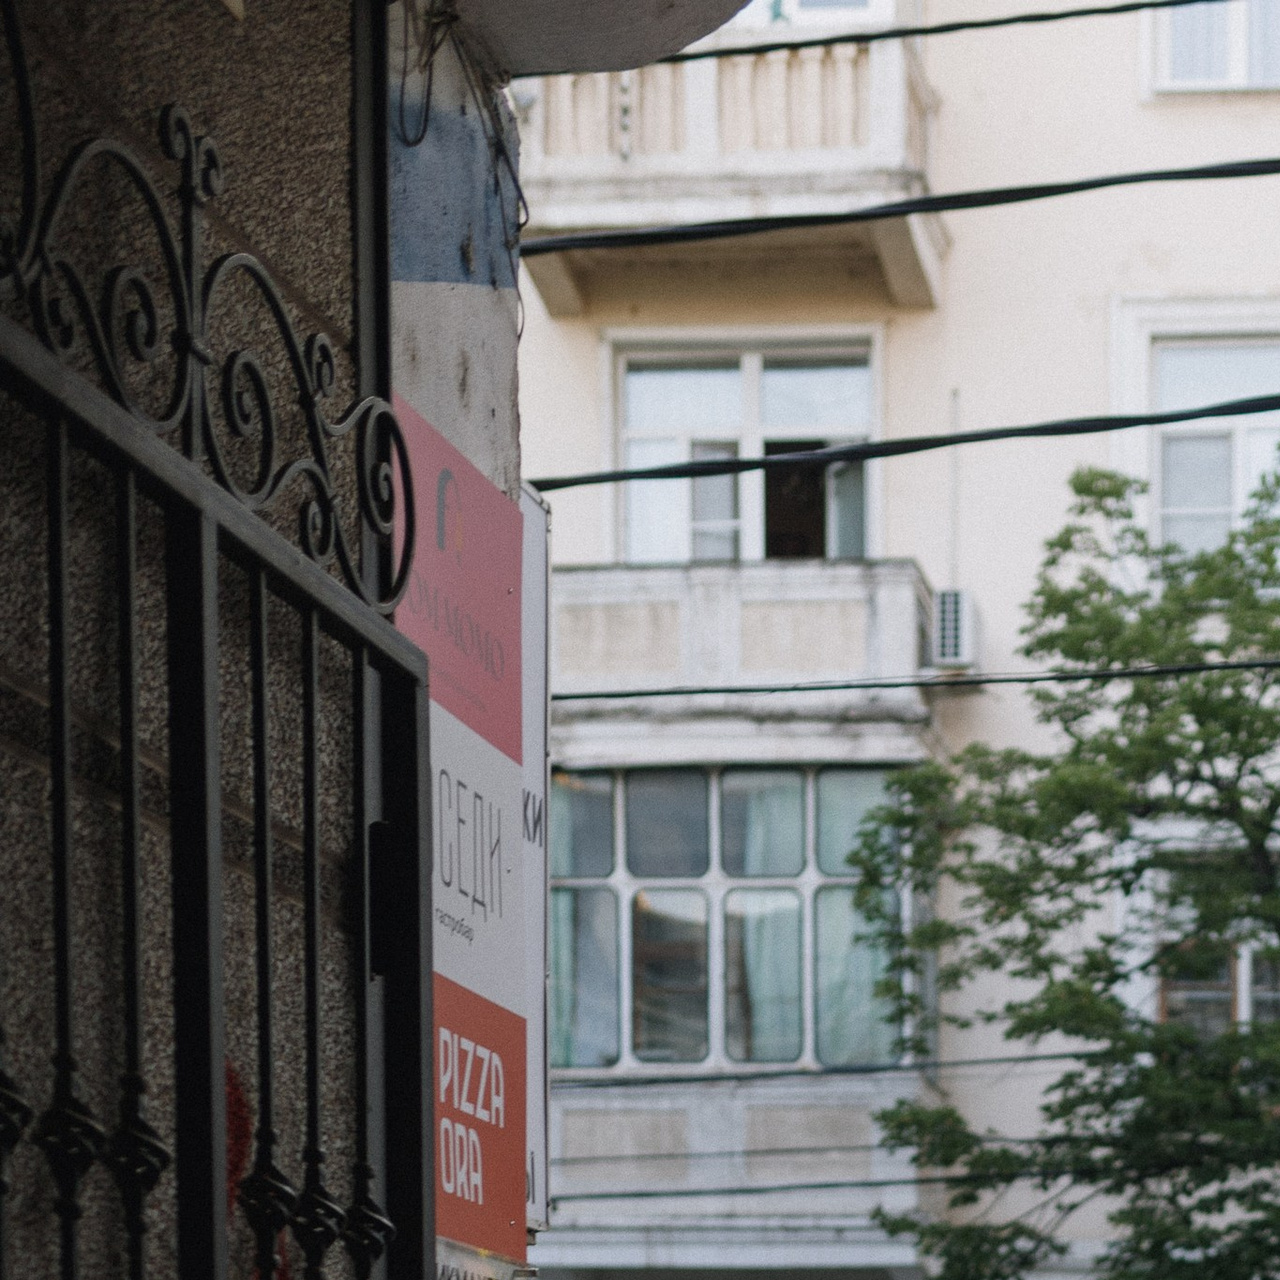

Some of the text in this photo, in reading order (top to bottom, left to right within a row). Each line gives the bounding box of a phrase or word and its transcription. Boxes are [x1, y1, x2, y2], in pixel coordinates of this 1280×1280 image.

[440, 769, 503, 922] СЕДИ
[438, 1026, 505, 1129] PIZZA
[440, 1117, 484, 1206] ORA
